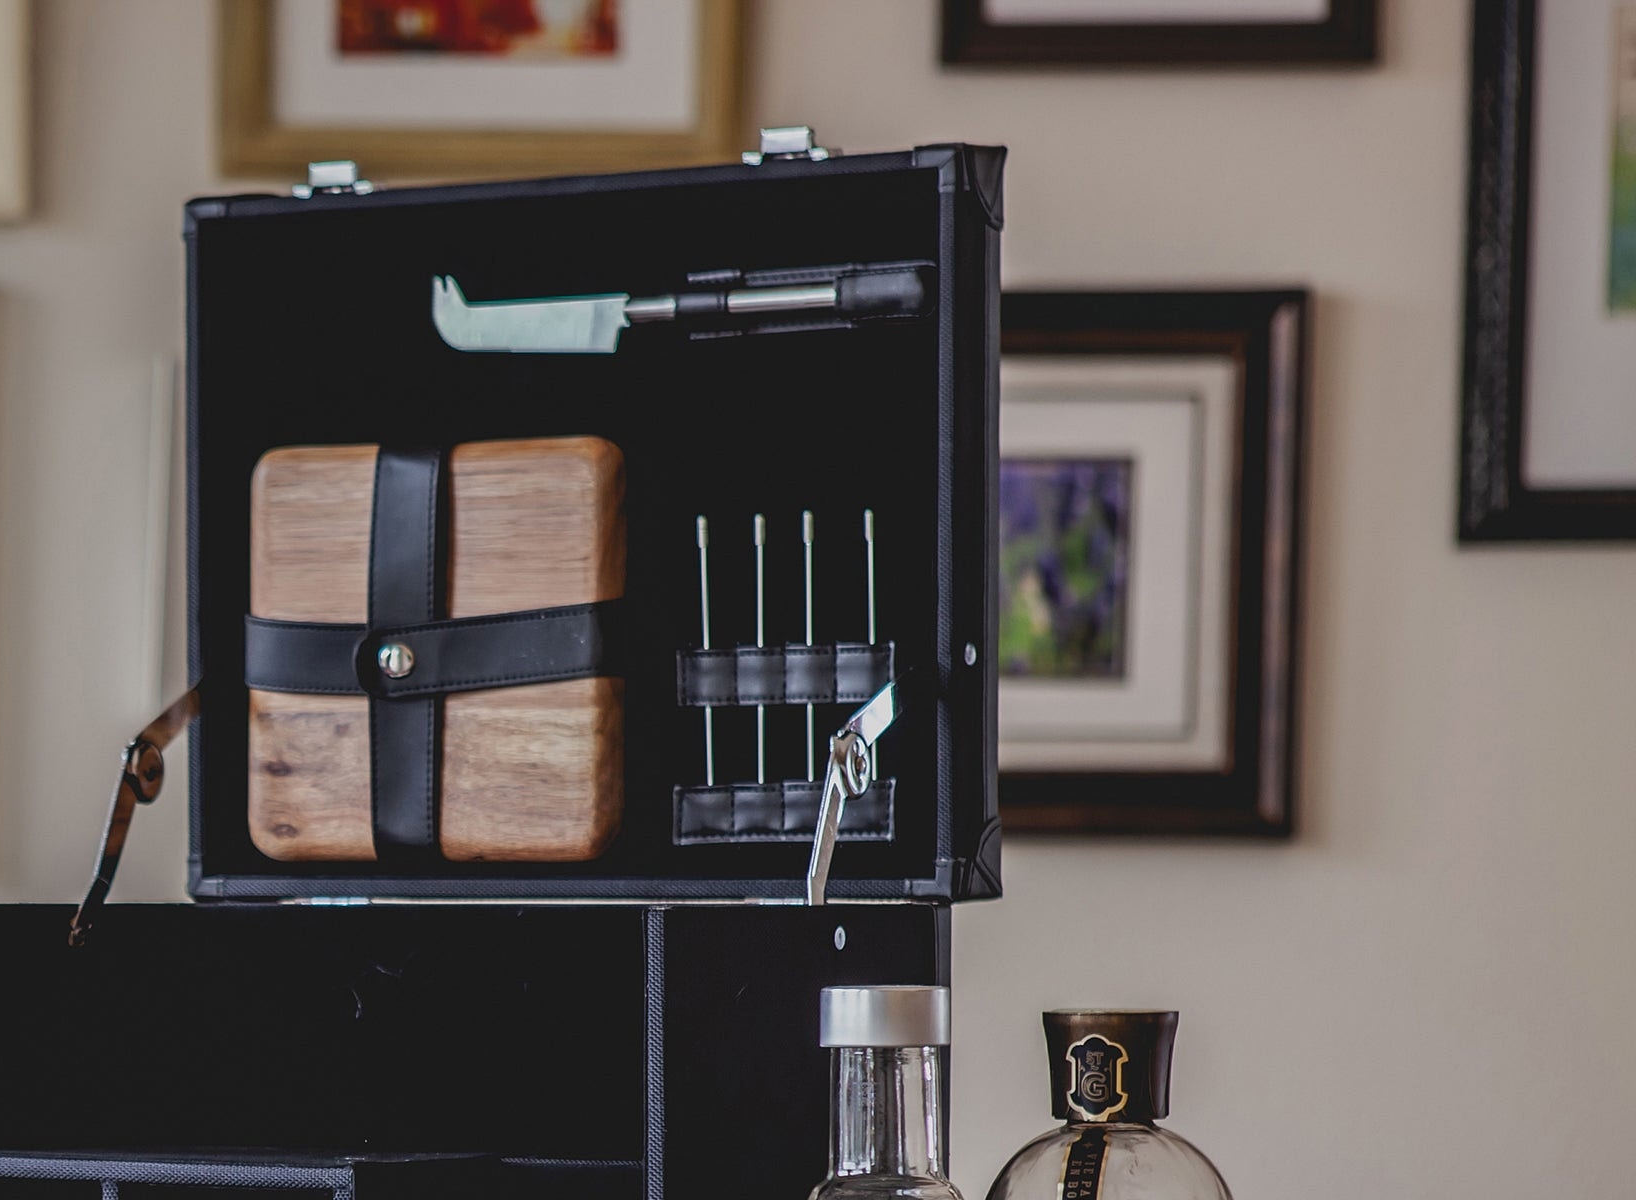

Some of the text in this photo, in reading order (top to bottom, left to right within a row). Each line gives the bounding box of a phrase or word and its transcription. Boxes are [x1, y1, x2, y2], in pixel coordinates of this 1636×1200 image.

[1085, 1050, 1105, 1067] ST
[1080, 1071, 1110, 1103] G
[1069, 1159, 1082, 1176] EN
[1082, 1152, 1098, 1175] VIE
